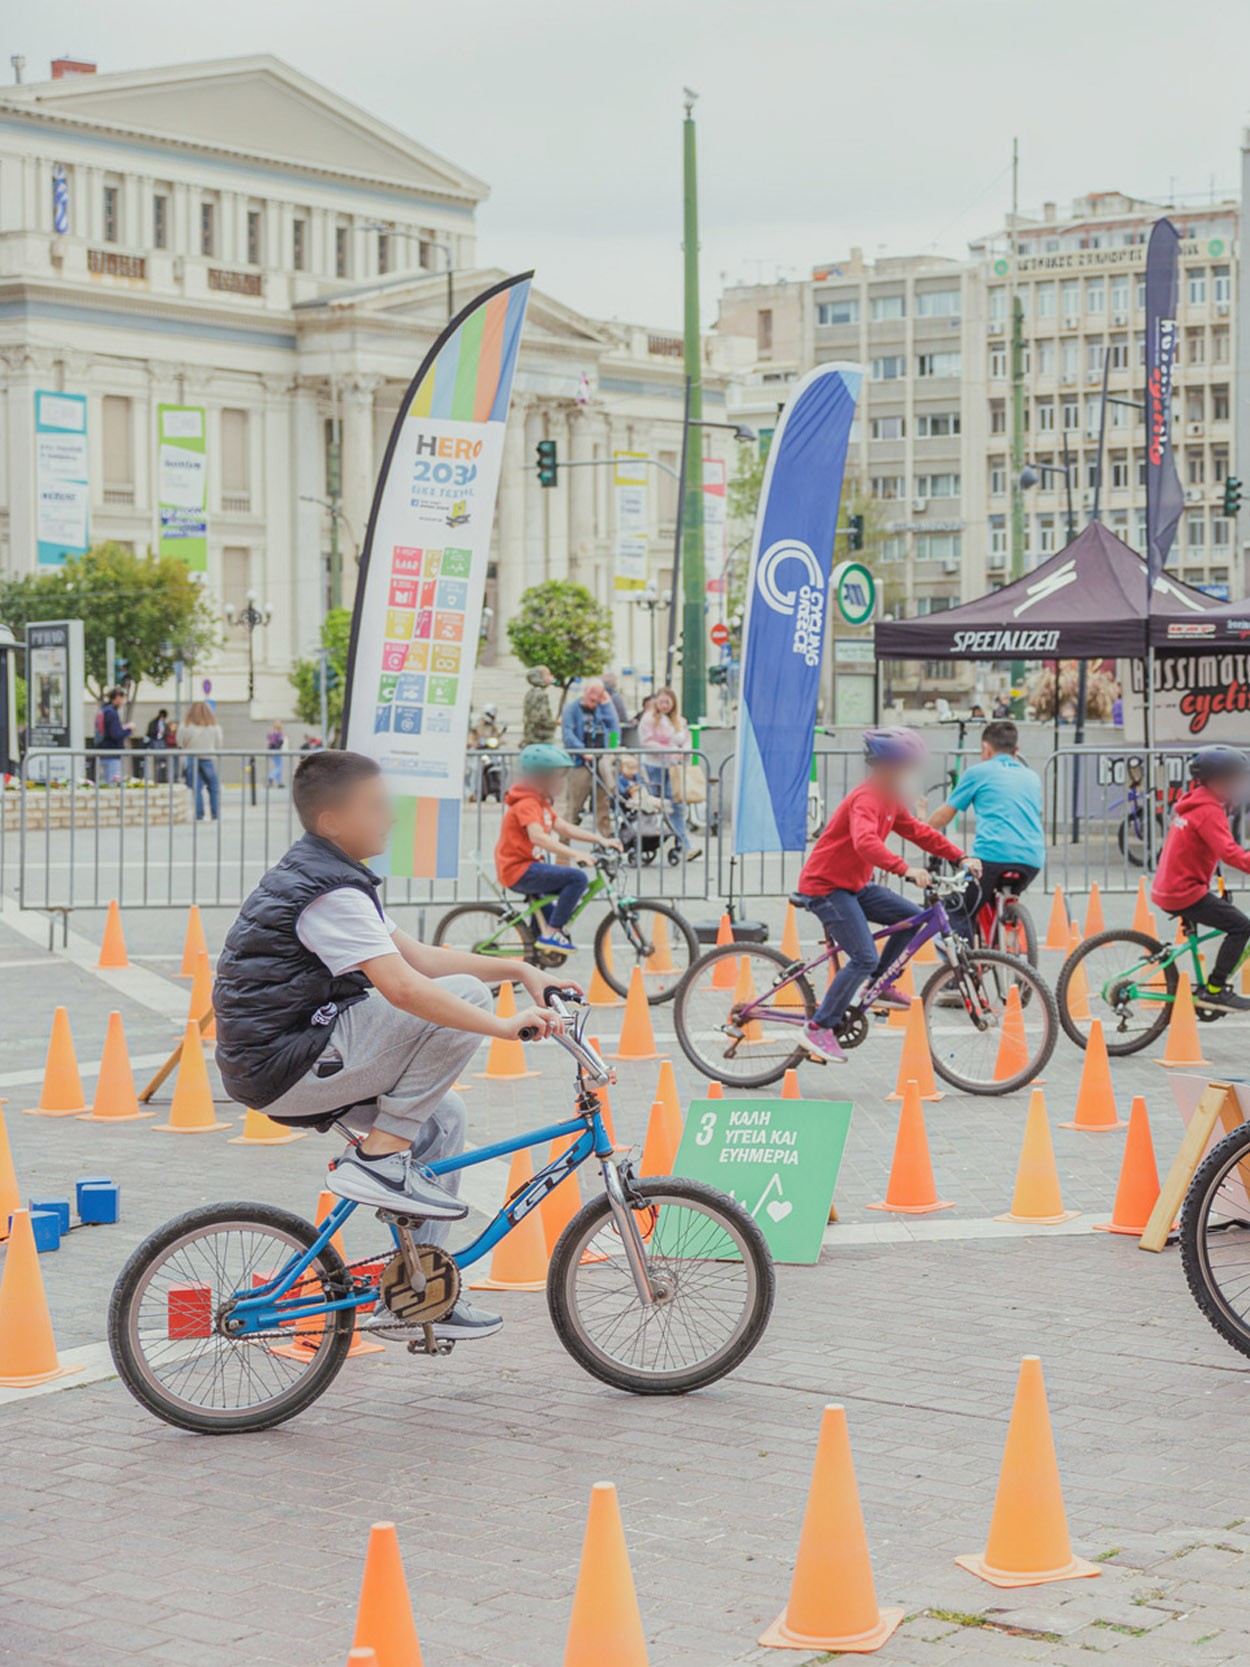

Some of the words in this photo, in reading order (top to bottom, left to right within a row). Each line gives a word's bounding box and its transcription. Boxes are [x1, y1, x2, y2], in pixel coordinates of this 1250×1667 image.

[792, 584, 812, 655] GREECE
[805, 591, 824, 667] CYCLING
[949, 630, 1060, 652] SPECIALIZED
[695, 1112, 717, 1146] 3
[728, 1111, 771, 1126] ΚΑΛΗ
[725, 1129, 767, 1145] ΥΓΕΙΑ
[769, 1130, 798, 1146] ΚΑΙ
[719, 1148, 799, 1166] ΕΥΗΜΕΡΙΑ
